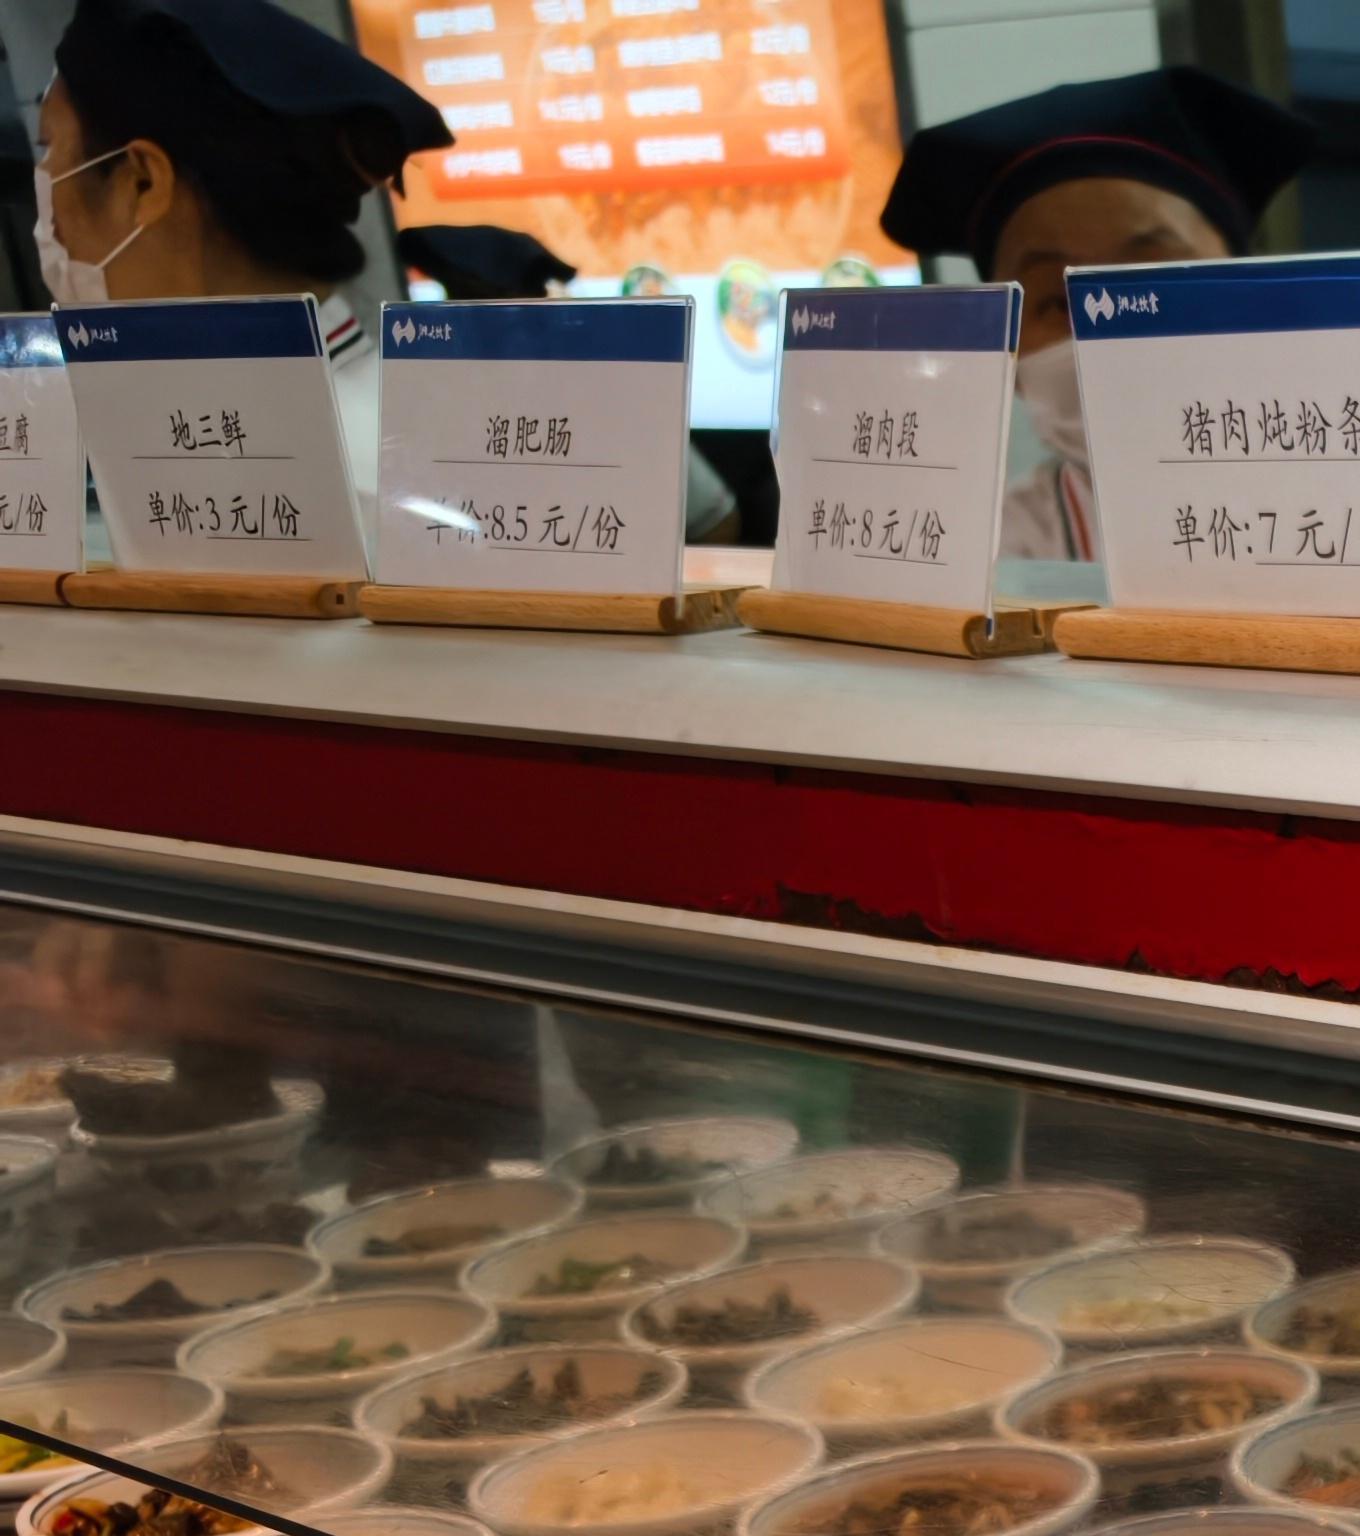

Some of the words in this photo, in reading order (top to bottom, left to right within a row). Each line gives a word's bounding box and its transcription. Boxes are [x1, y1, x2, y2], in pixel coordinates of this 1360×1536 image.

[170, 408, 248, 456] 地三鲜
[486, 414, 572, 459] 溜肥肠
[852, 408, 919, 460] 溜肉段
